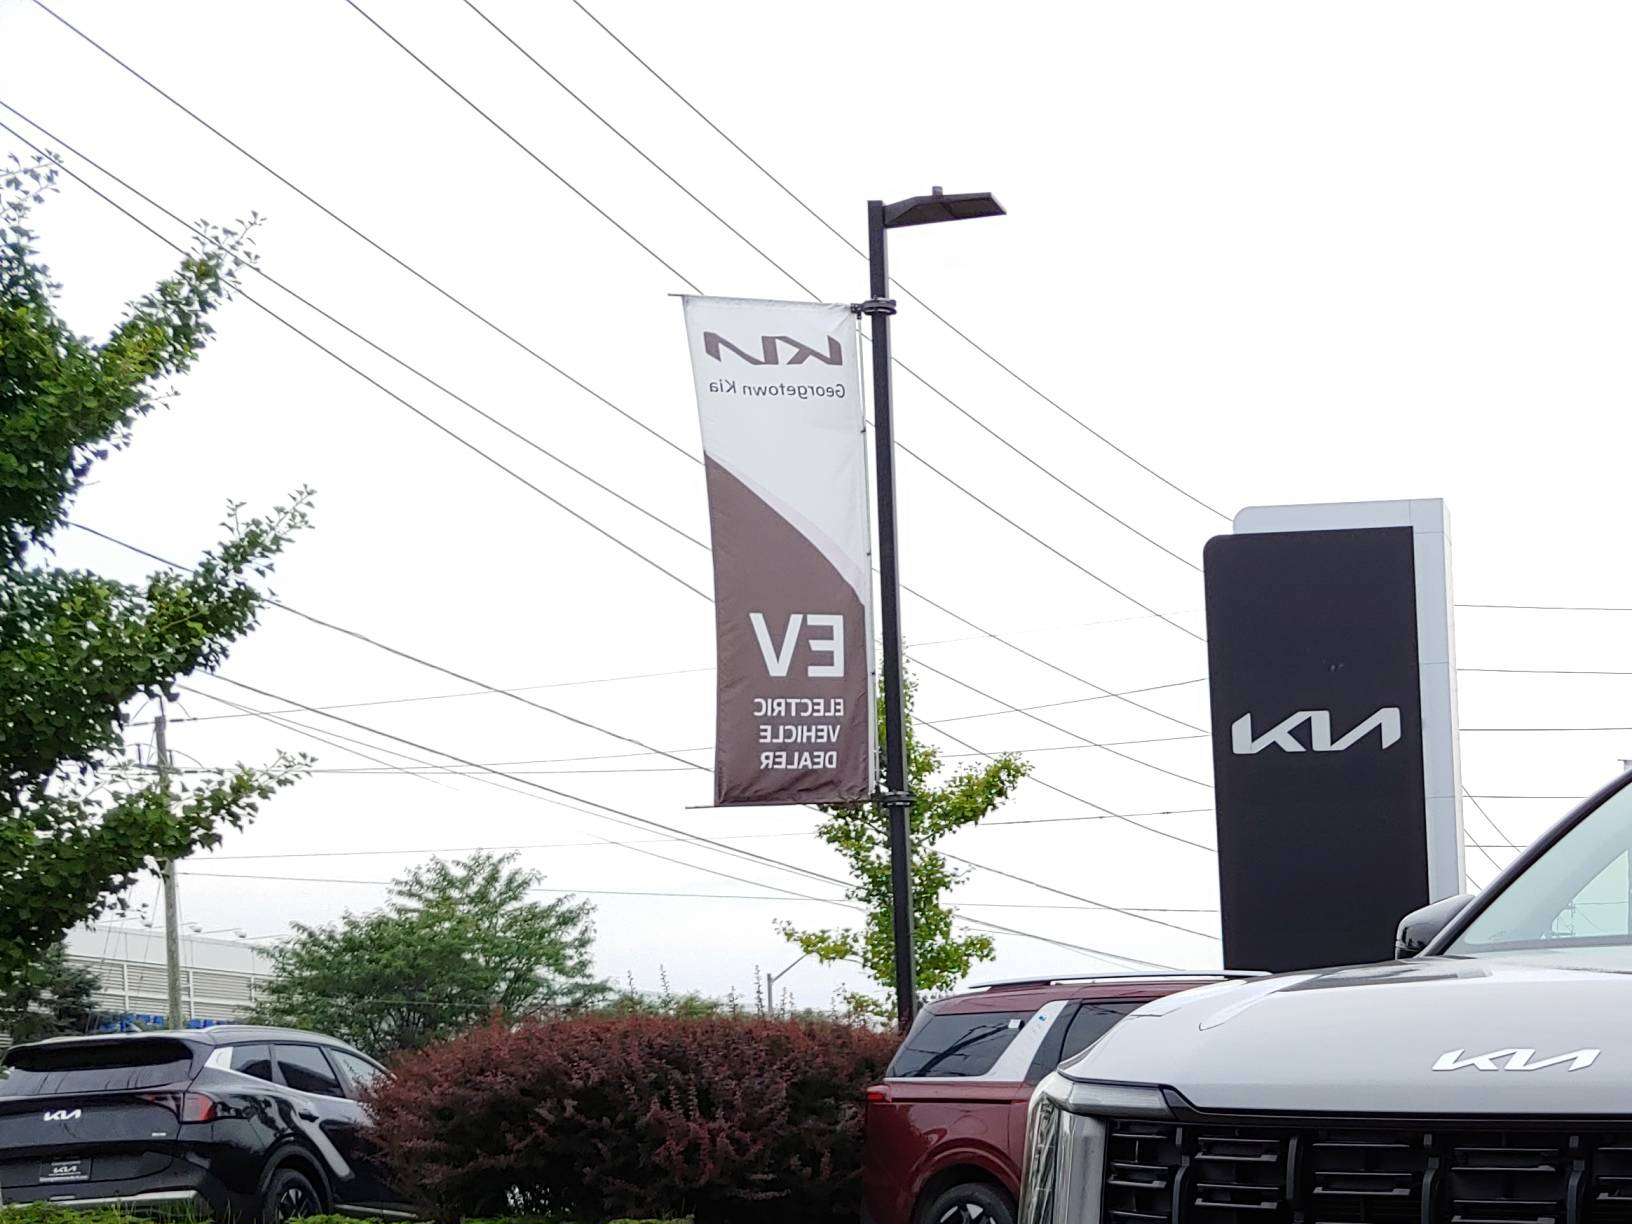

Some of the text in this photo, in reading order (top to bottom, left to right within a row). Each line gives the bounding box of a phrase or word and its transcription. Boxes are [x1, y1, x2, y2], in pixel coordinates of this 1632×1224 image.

[1231, 707, 1401, 754] KIA
[1431, 1048, 1602, 1072] KIA
[43, 1108, 82, 1121] KIA
